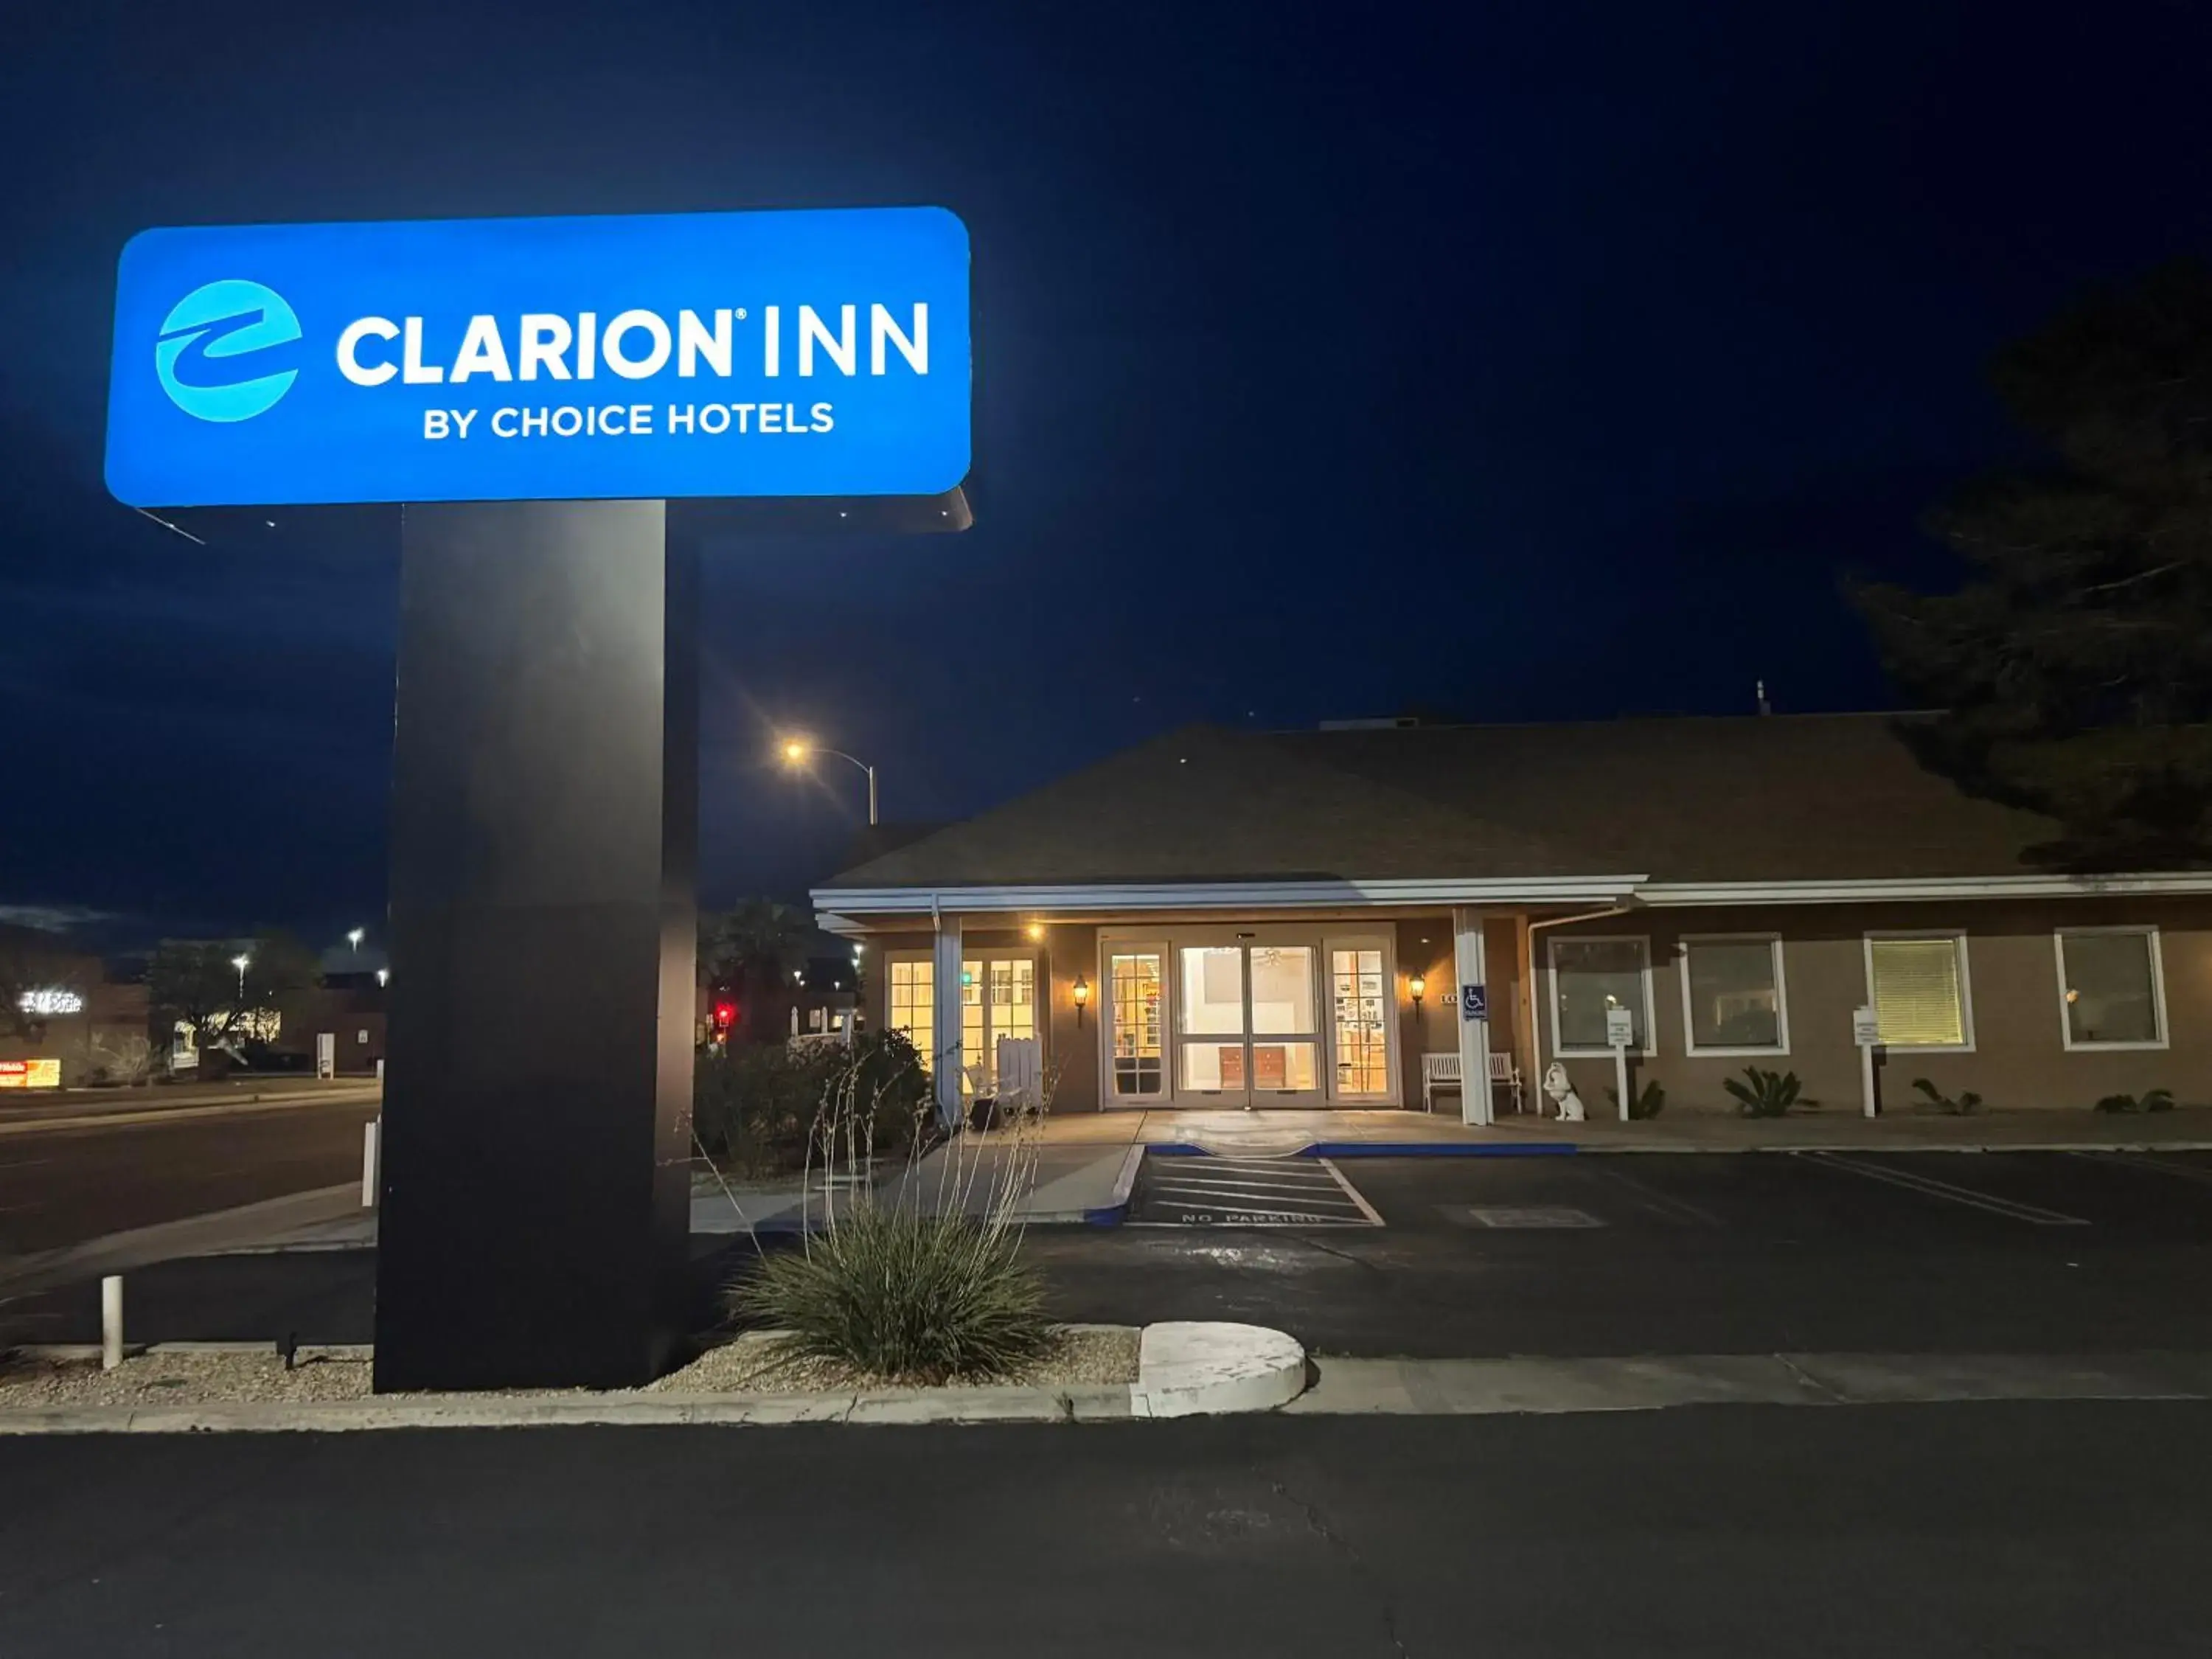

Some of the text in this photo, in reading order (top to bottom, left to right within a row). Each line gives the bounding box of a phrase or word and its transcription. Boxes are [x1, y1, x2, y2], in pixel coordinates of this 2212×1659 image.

[765, 302, 928, 378] INN
[424, 402, 835, 439] BY CHOICE HOTELS
[1182, 1214, 1212, 1222] NO
